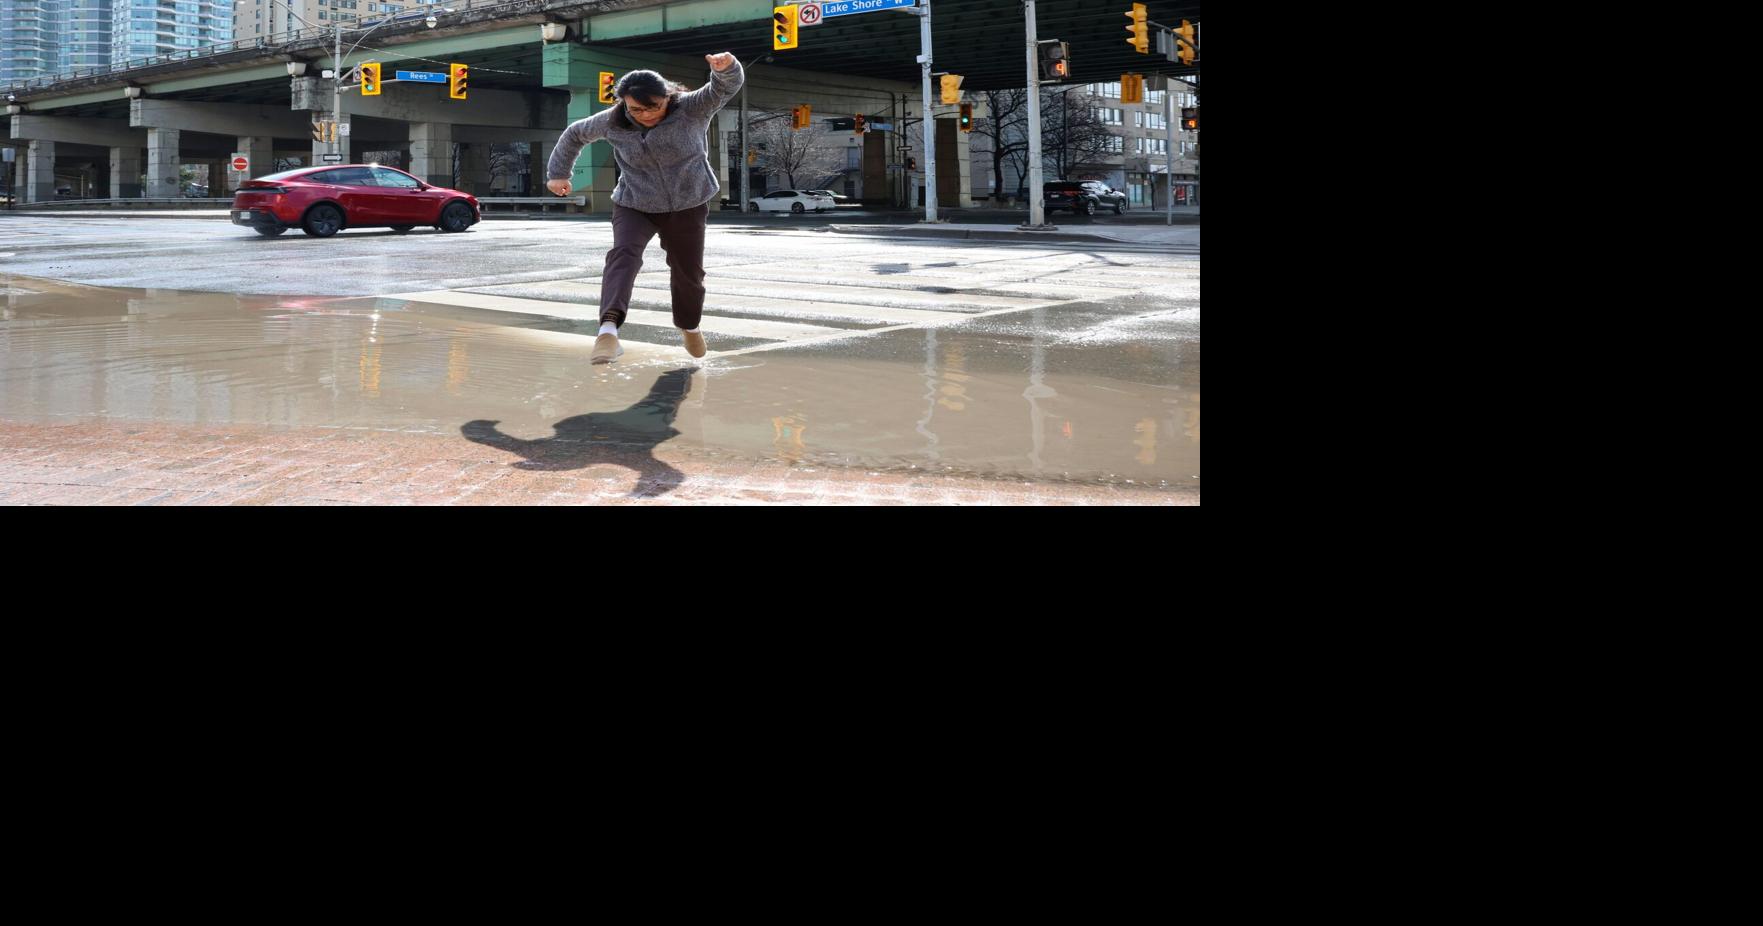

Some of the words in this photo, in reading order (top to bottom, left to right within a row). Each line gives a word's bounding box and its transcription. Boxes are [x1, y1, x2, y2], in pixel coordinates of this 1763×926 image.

[825, 4, 848, 14] Lake
[852, 0, 882, 10] Shore
[410, 72, 427, 80] Rees
